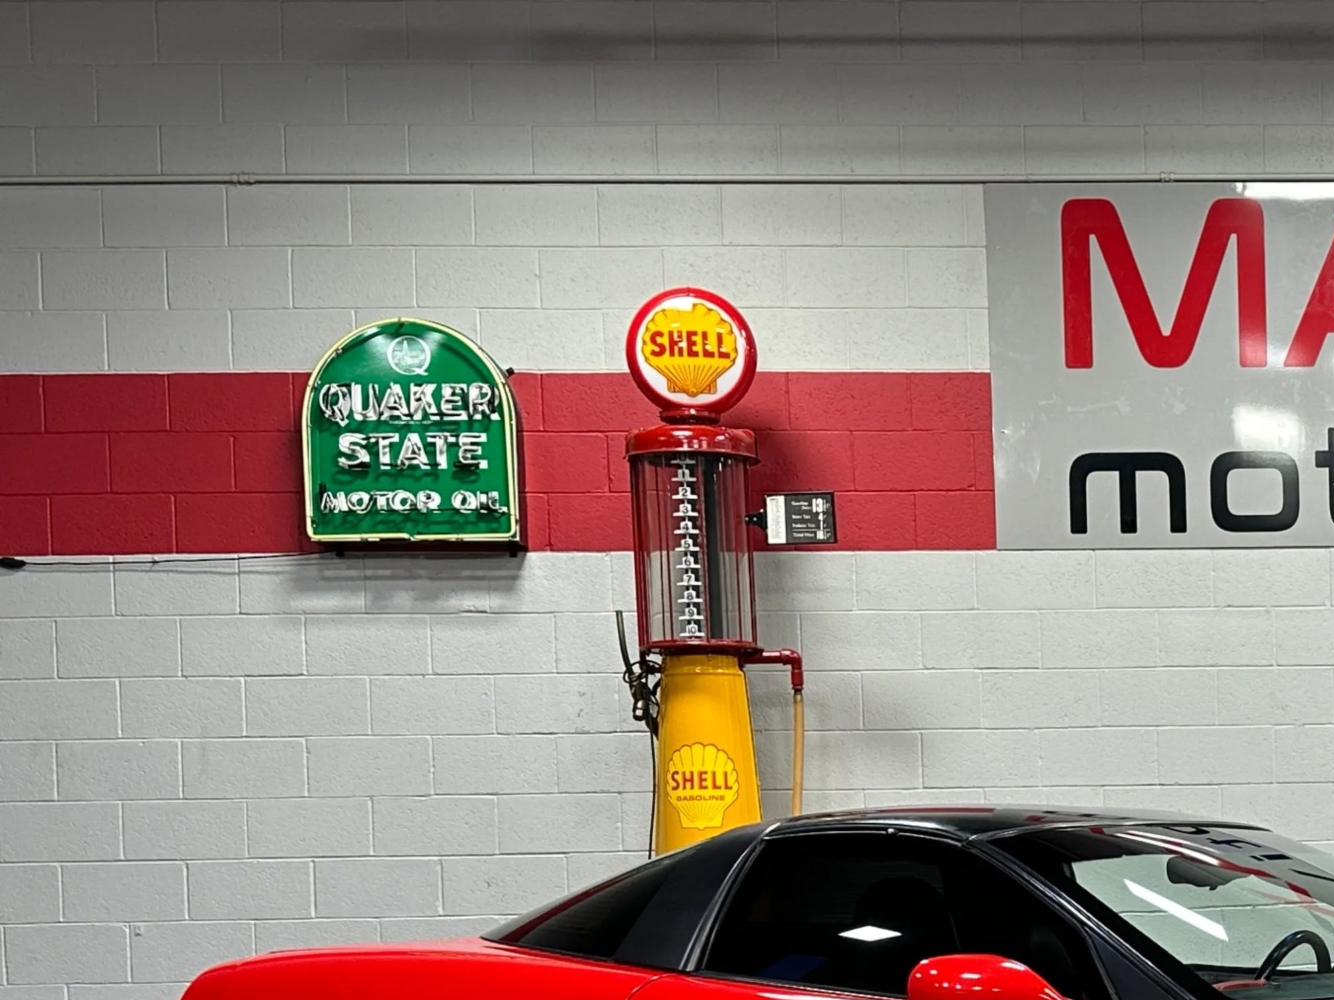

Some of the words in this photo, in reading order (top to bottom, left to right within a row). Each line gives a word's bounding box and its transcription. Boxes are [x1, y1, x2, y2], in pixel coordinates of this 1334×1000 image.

[649, 328, 732, 360] SHELL
[318, 381, 501, 427] QUAKER
[337, 431, 489, 470] STATE
[320, 489, 442, 514] MOTOR
[687, 626, 698, 635] 10
[671, 770, 733, 791] SHELL
